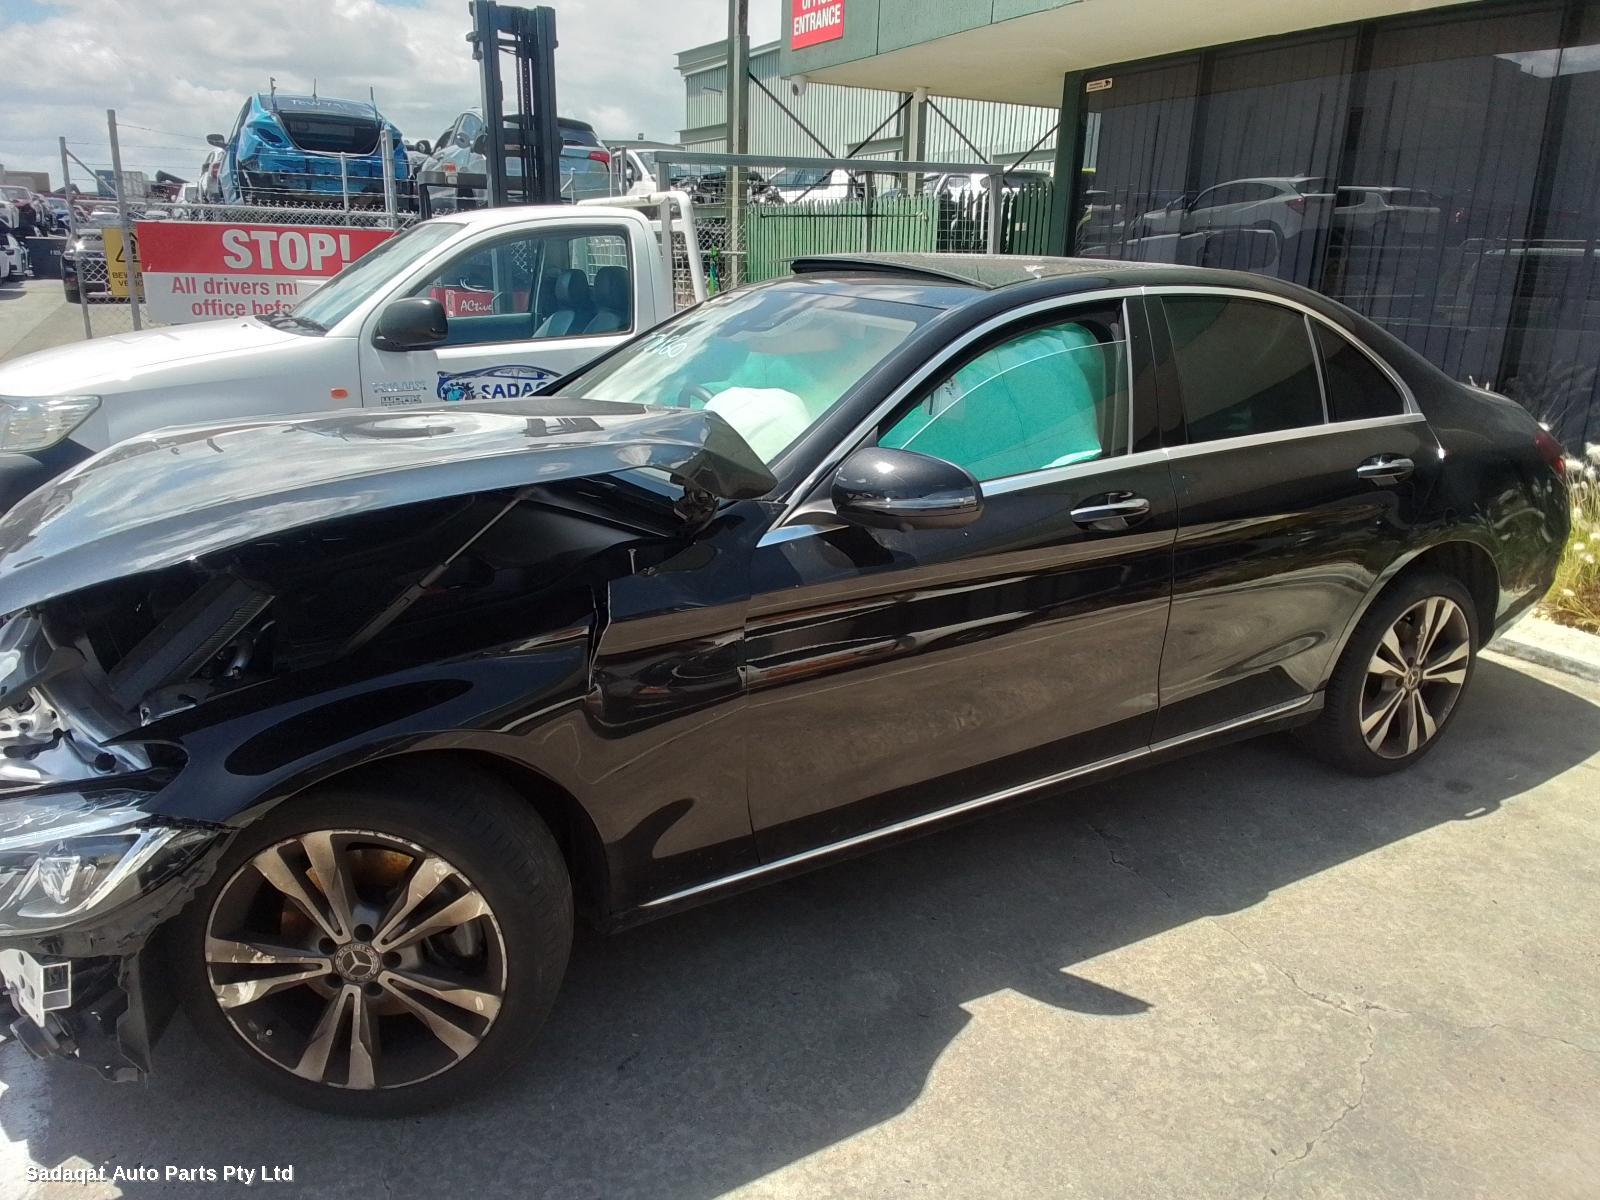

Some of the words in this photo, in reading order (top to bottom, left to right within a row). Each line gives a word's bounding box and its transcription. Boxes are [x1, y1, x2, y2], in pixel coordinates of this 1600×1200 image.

[793, 3, 841, 36] ENTRANCE
[222, 229, 350, 271] STOP!
[172, 276, 197, 294] All
[203, 277, 270, 295] drivers
[191, 298, 246, 316] office
